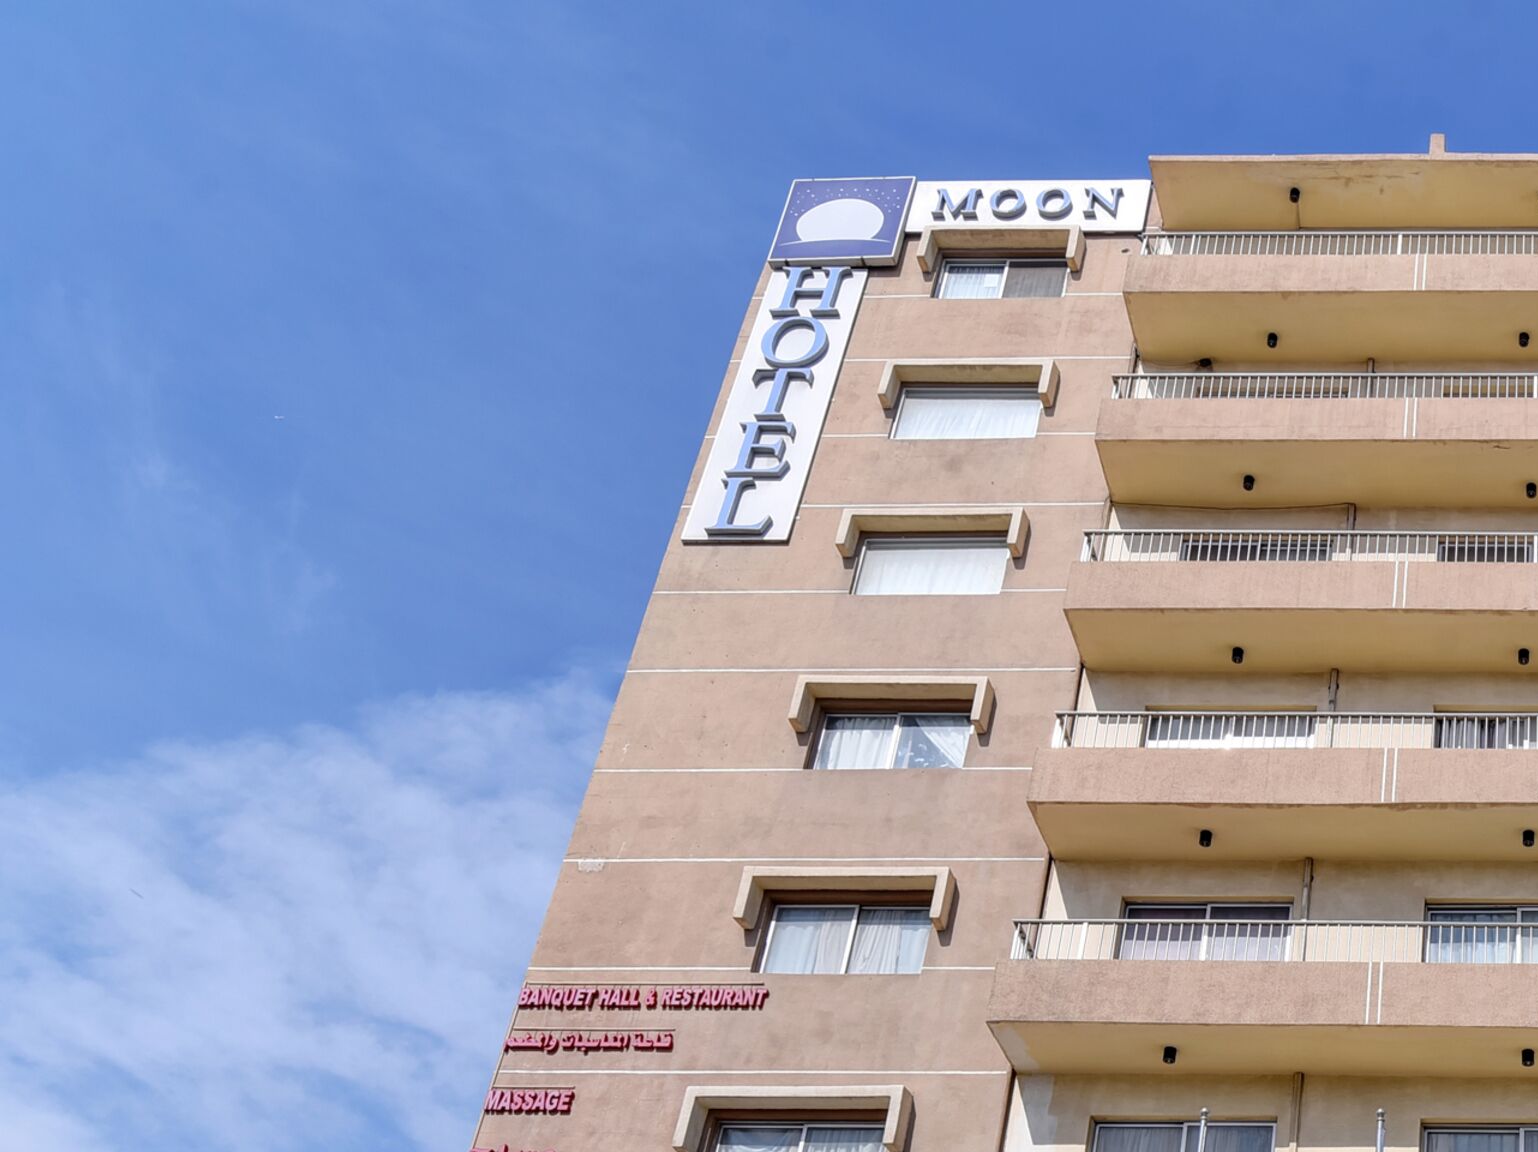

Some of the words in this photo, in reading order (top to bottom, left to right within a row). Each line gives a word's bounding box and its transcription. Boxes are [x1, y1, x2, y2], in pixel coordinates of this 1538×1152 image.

[930, 186, 1124, 221] MOON
[704, 265, 853, 536] HOTEL
[518, 987, 598, 1010] BANQUET
[598, 988, 641, 1010] HALL
[644, 988, 657, 1010] &
[661, 988, 768, 1010] RESTAURANT
[484, 1089, 575, 1114] MASSAGE
